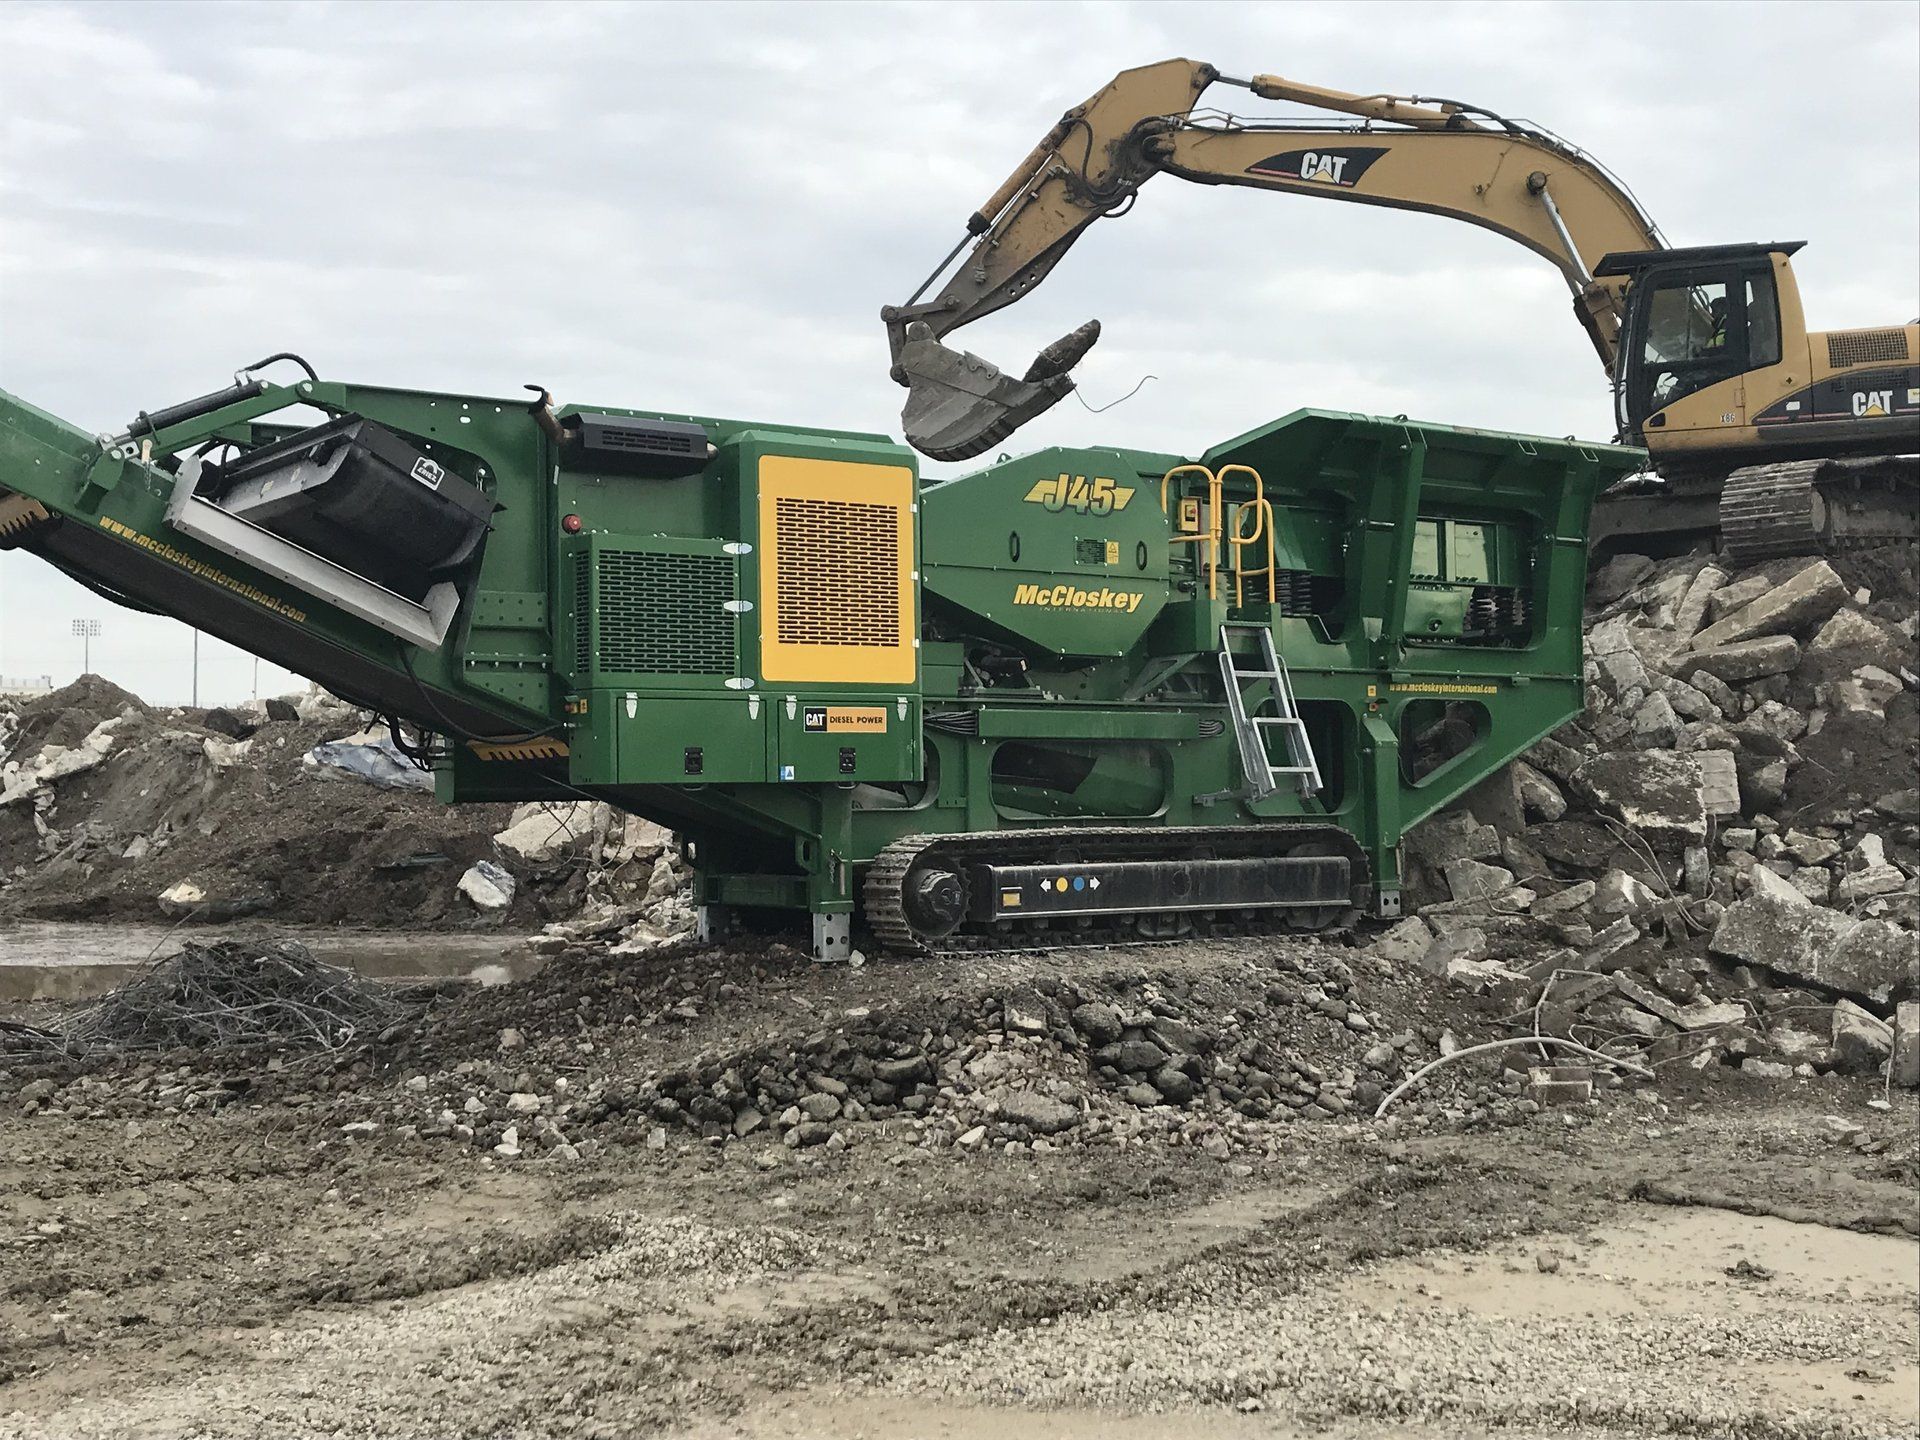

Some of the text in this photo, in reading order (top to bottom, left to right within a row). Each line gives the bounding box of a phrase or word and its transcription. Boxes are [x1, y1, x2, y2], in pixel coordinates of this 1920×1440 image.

[1300, 152, 1349, 184] CAT
[1852, 390, 1893, 416] CAT
[1042, 473, 1116, 517] J45
[100, 516, 307, 623] www.mccloskeyinternational.com
[1013, 584, 1144, 613] McCloskey
[1040, 606, 1124, 614] INTERNATIONAL
[1389, 682, 1498, 694] www.mccloskeyinternational.com
[805, 713, 826, 726] CAT
[829, 716, 883, 724] DIESEL POWER
